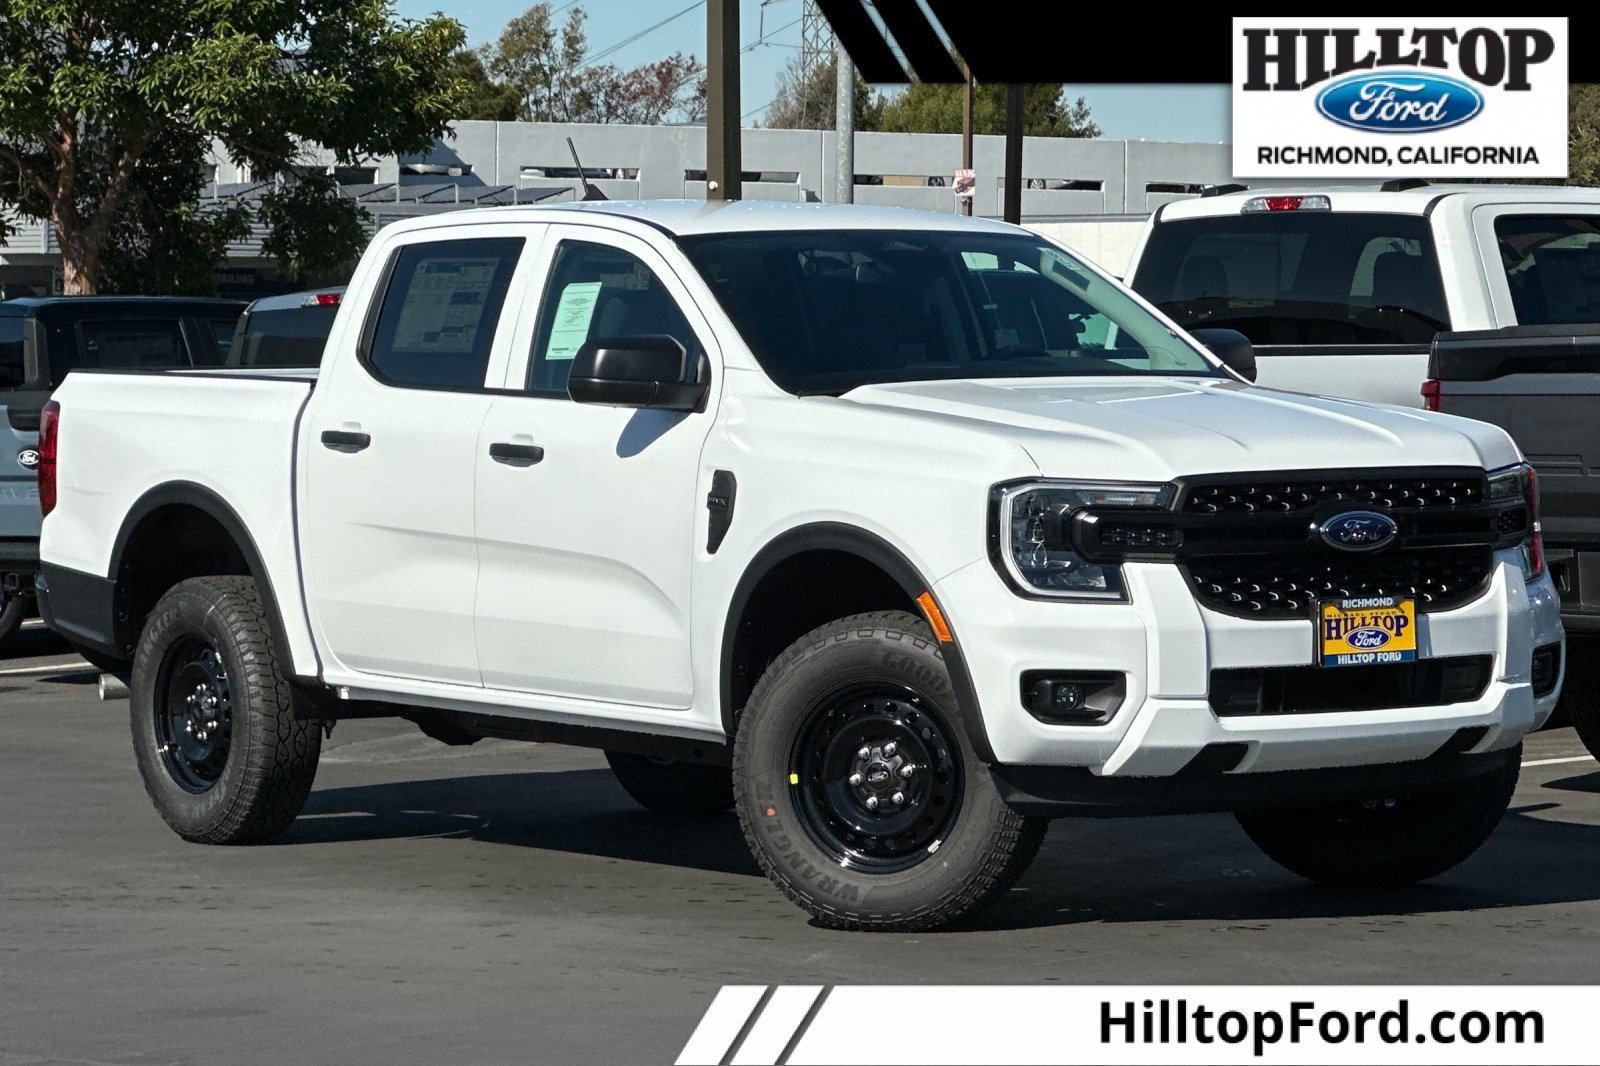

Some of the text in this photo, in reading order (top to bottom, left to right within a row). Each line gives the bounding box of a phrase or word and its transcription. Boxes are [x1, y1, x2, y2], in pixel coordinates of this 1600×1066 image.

[1342, 597, 1394, 609] RICHMOND
[1325, 614, 1409, 641] HILLTOP
[1354, 629, 1383, 647] Ford
[1337, 651, 1402, 665] HILLTOP FORD
